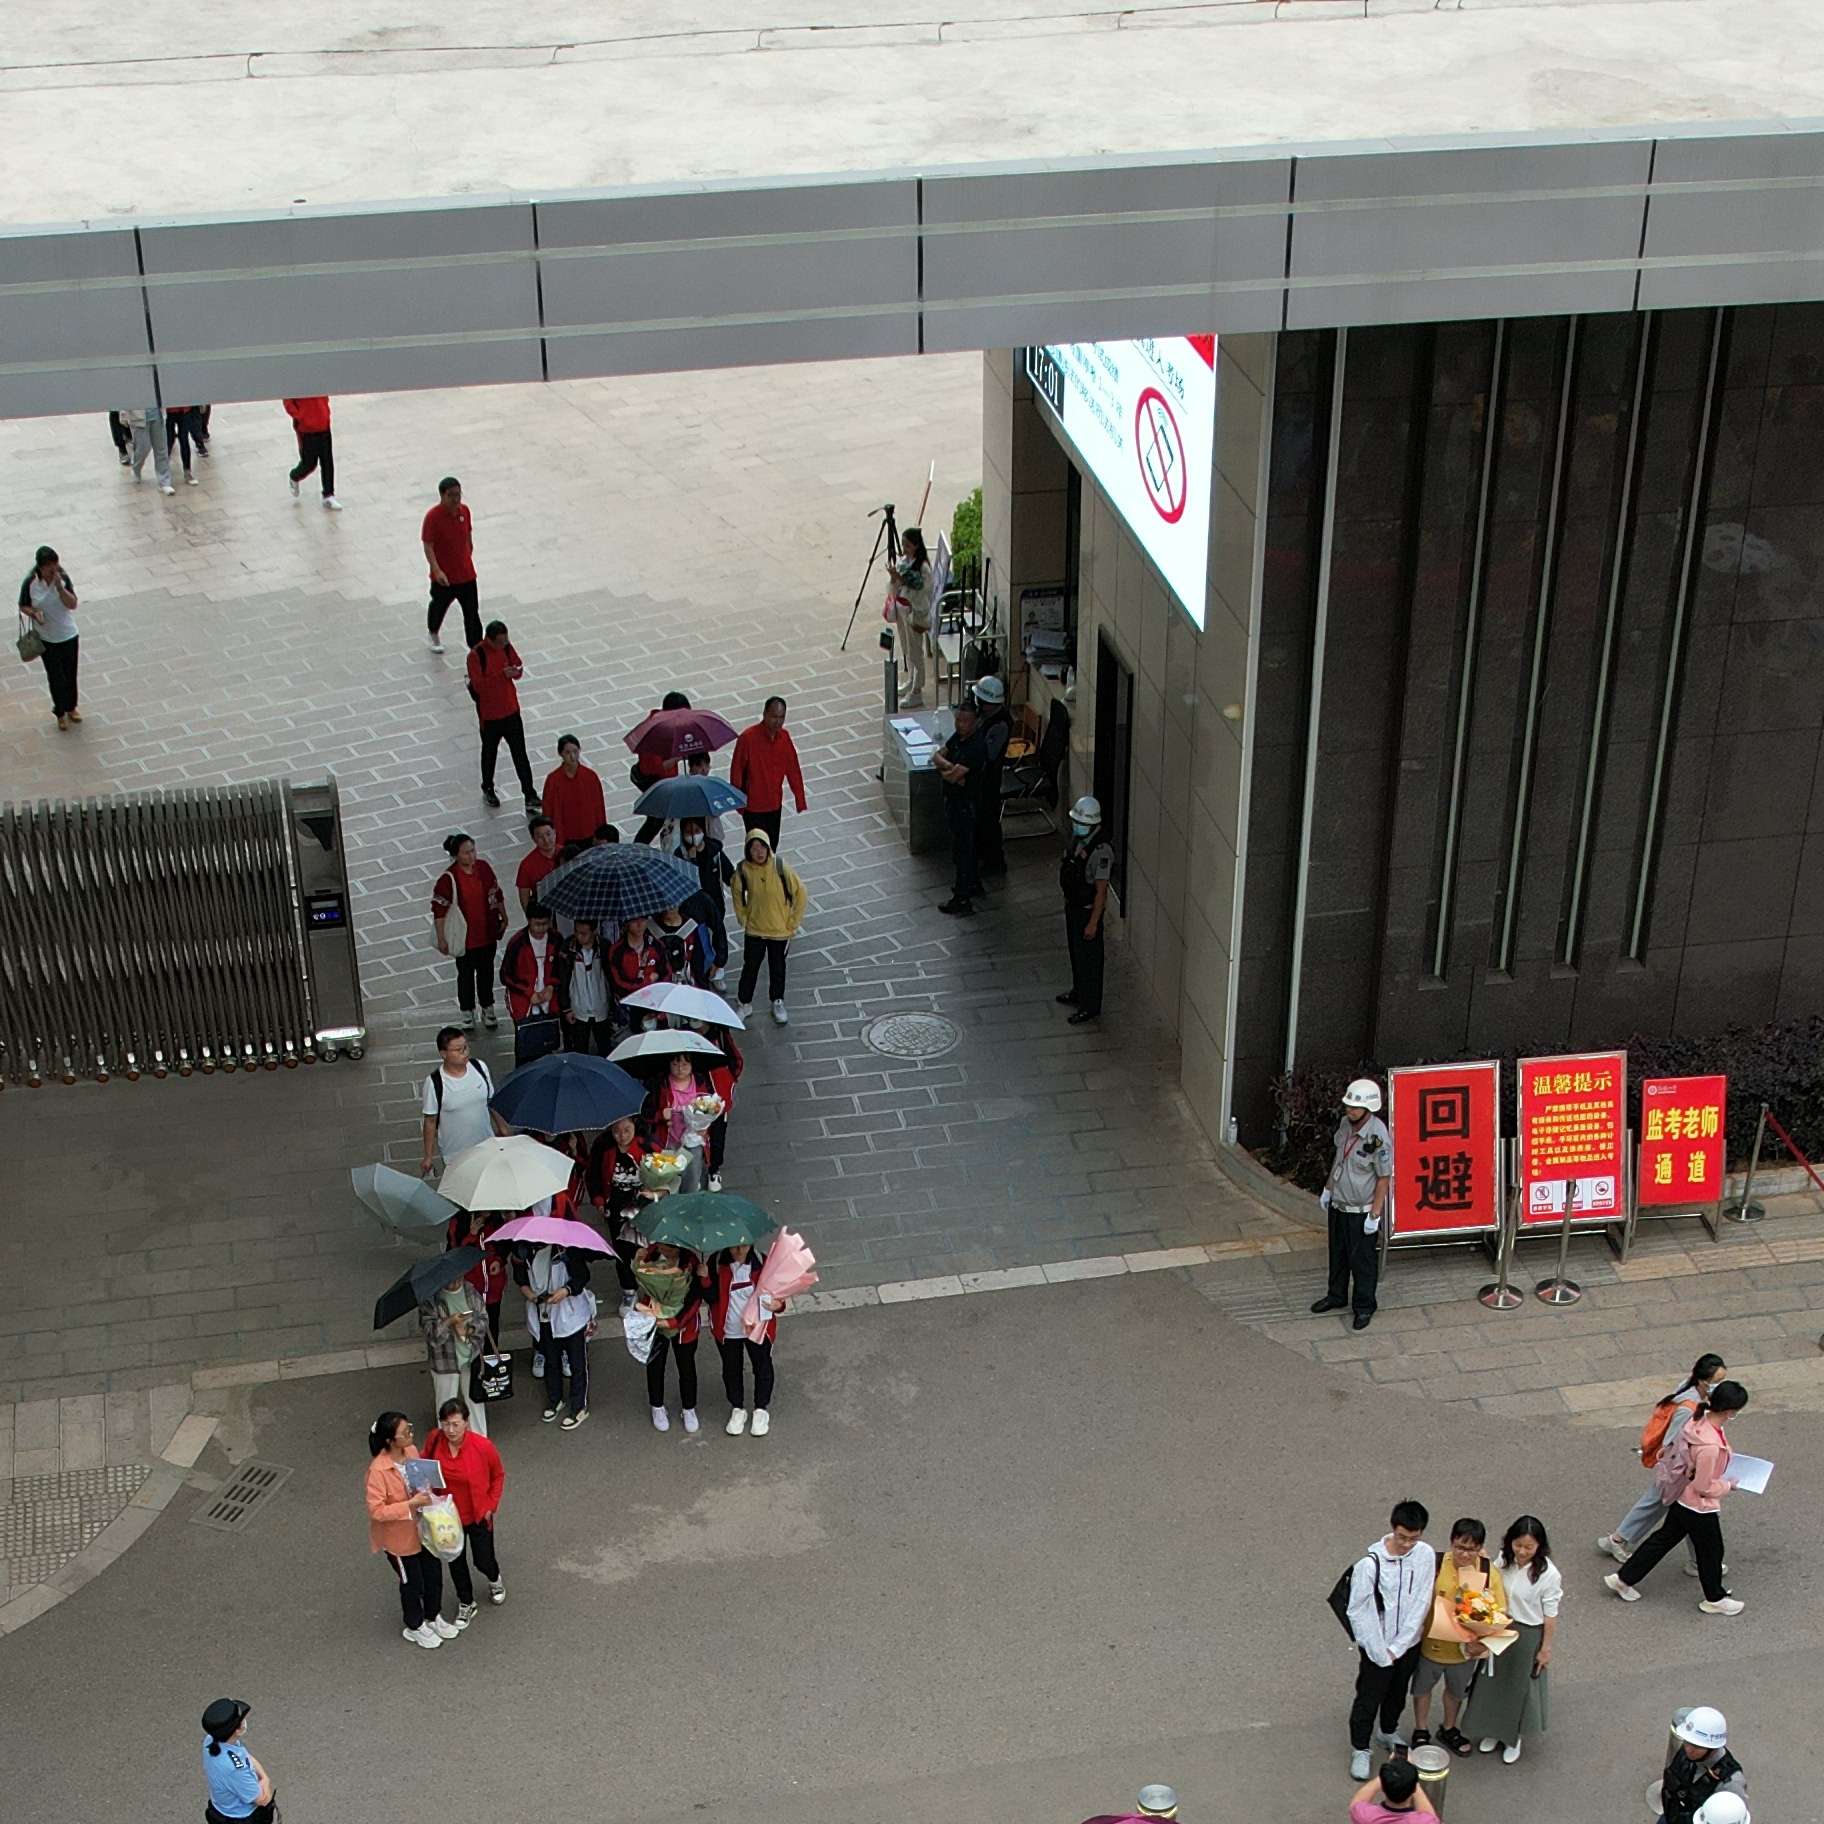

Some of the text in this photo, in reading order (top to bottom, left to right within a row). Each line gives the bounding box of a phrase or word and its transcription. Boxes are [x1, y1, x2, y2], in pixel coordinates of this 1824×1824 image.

[1532, 1070, 1613, 1096] 温馨提示
[1645, 1105, 1720, 1141] 监考老师
[1415, 1085, 1474, 1212] 回避
